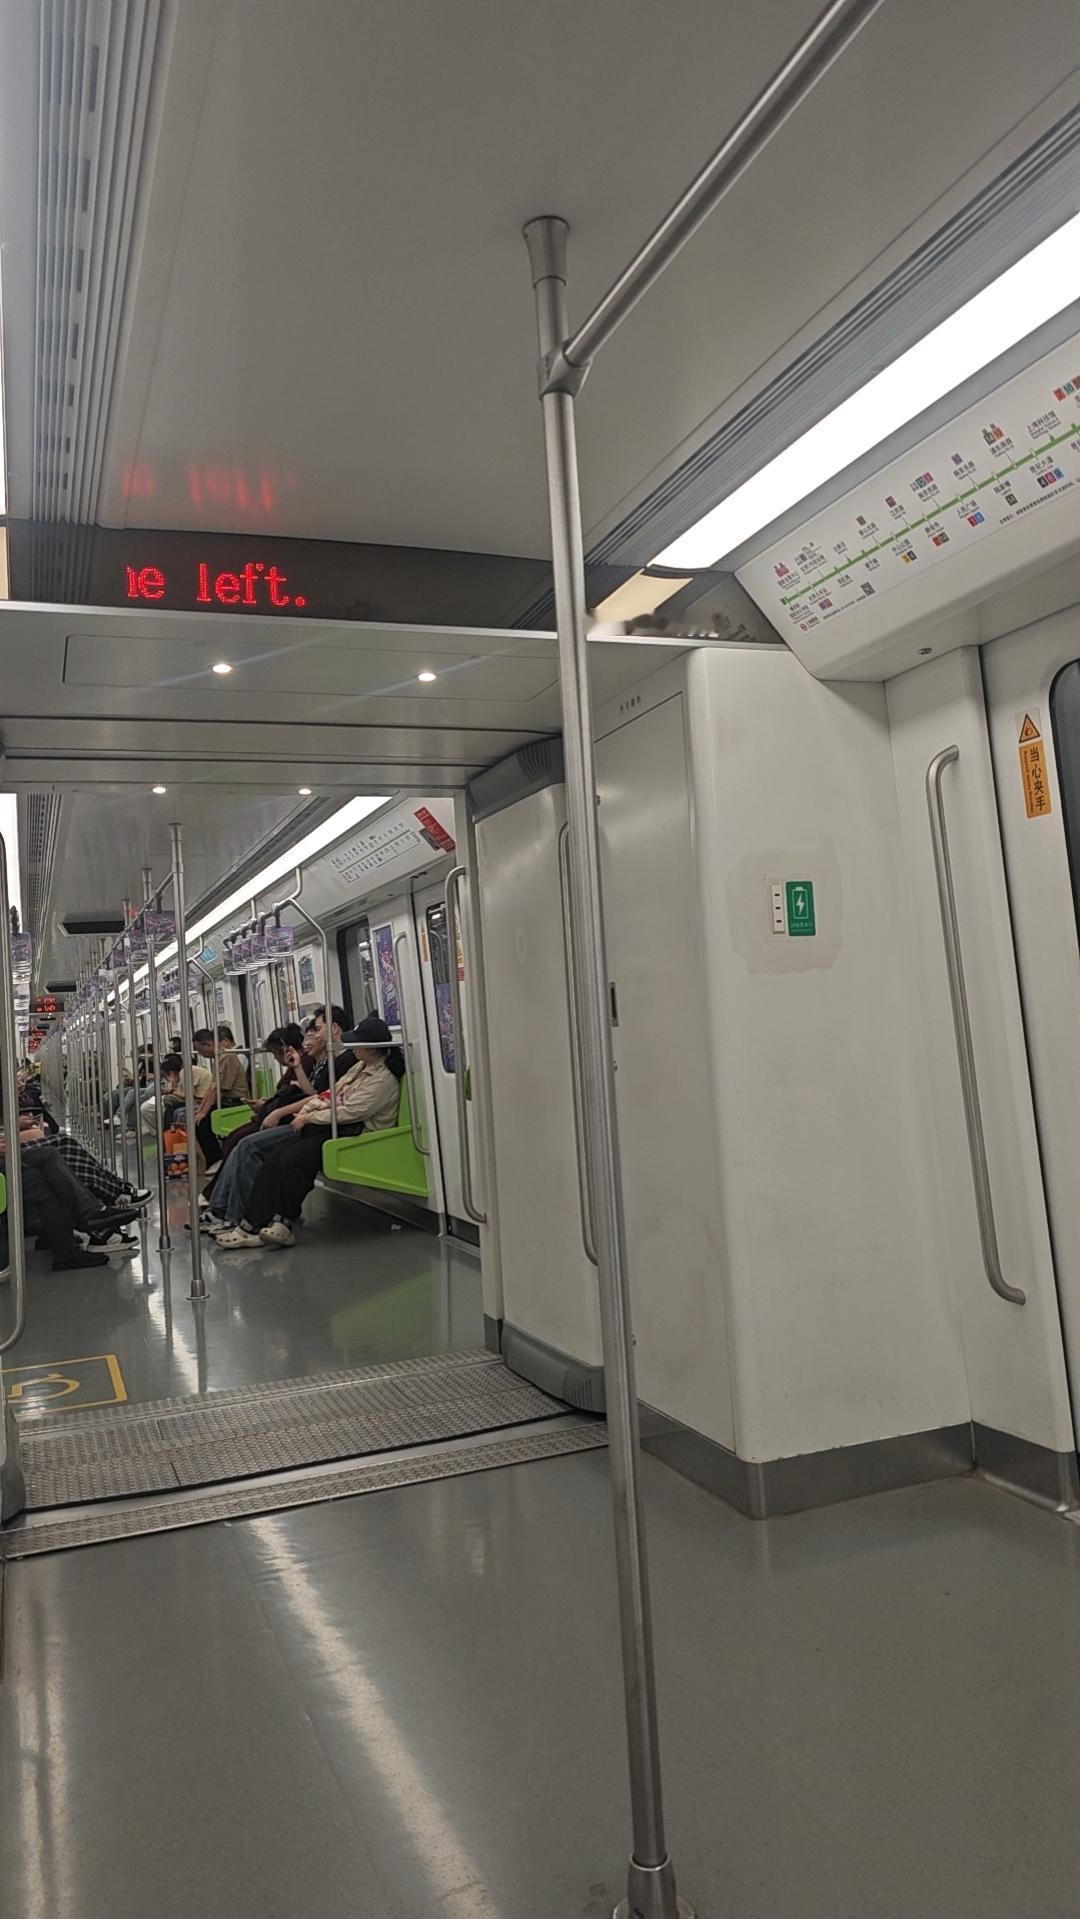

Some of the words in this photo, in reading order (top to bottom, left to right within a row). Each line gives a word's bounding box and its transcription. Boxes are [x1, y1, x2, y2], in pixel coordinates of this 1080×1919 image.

[196, 561, 308, 607] left.
[1029, 746, 1046, 811] 当心夹手
